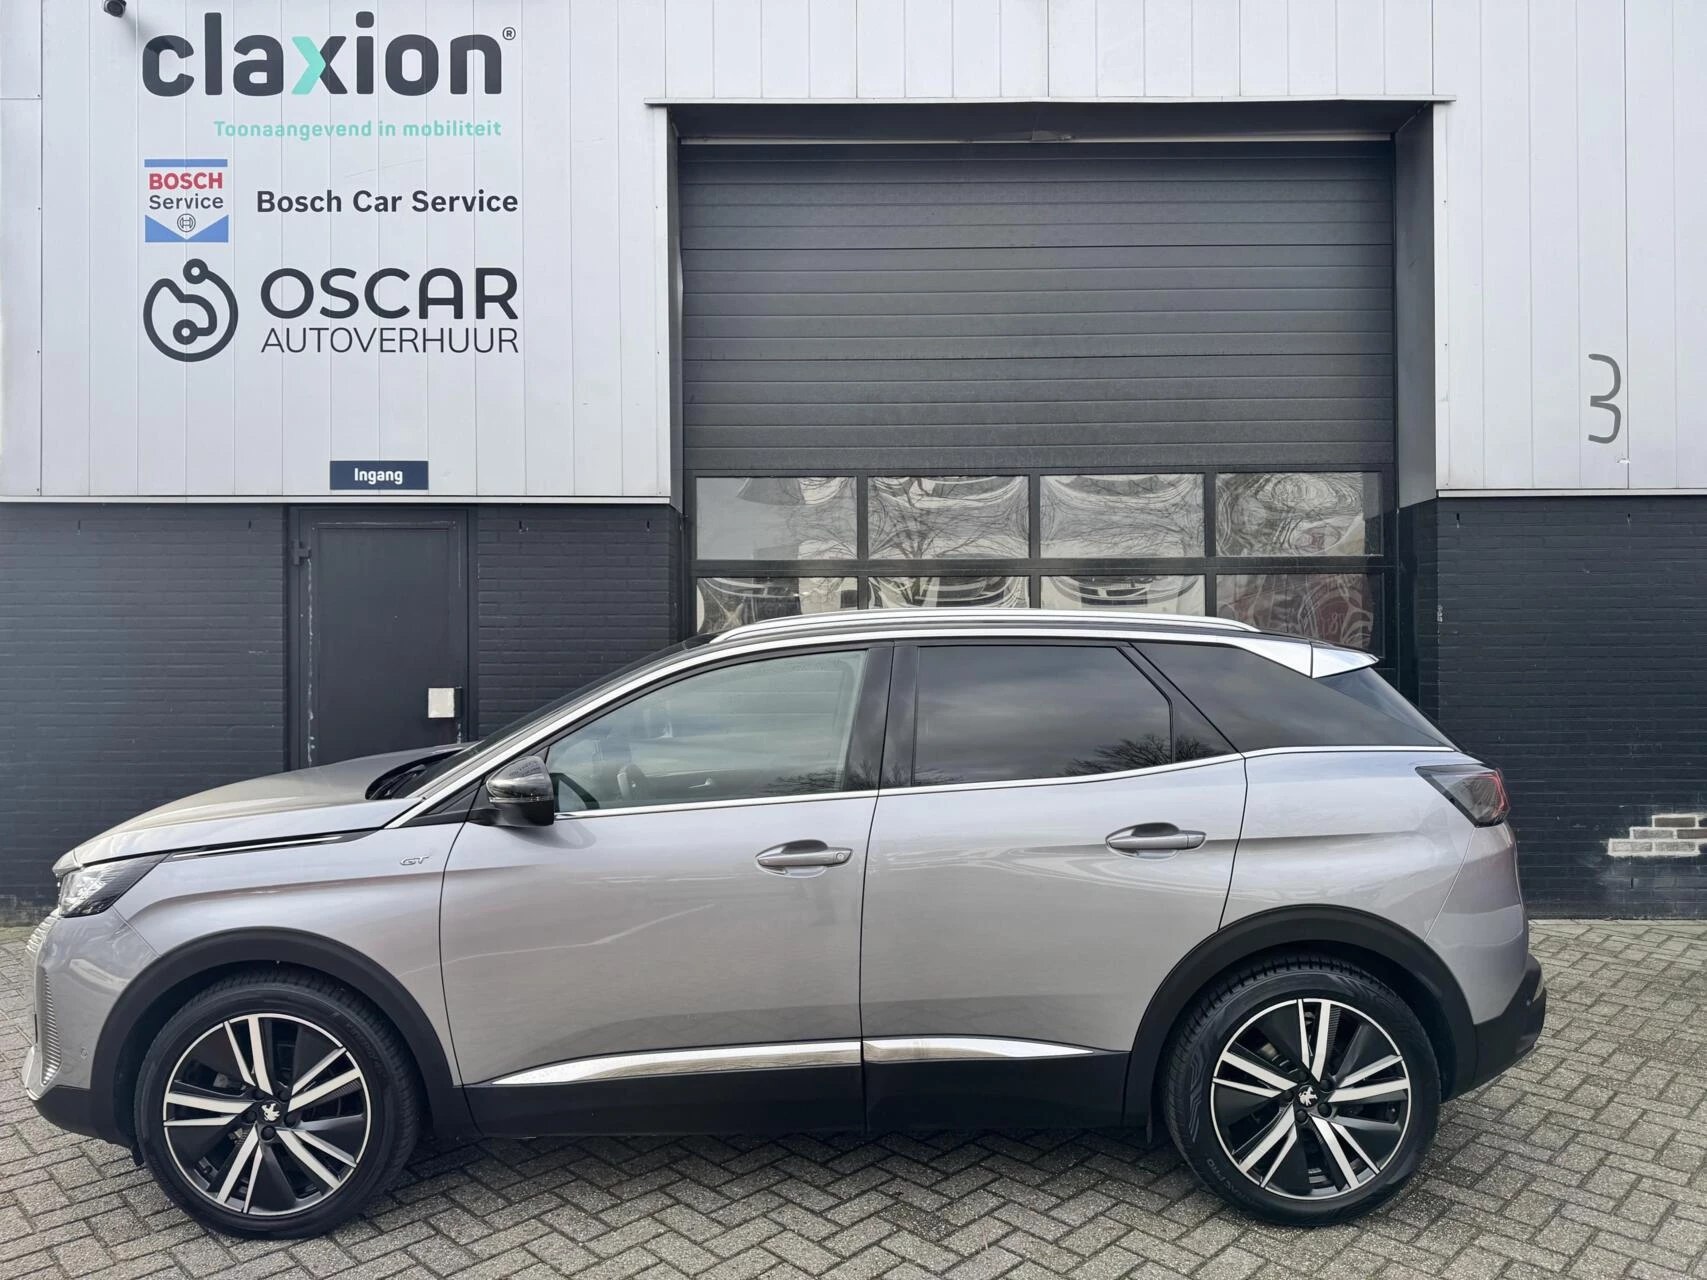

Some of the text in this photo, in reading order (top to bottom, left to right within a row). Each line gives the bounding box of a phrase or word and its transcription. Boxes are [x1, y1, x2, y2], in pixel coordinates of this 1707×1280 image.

[143, 11, 502, 97] claxion
[214, 120, 502, 142] Toonaangevend in mobiliteit
[149, 172, 223, 190] BOSCH
[149, 194, 224, 210] Service
[257, 189, 519, 213] Bosch Car Service
[260, 267, 519, 320] OSCAR
[260, 327, 519, 353] AUTOVERHUUR
[1588, 353, 1622, 444] 3
[354, 467, 403, 485] Ingang
[400, 855, 430, 866] GT
